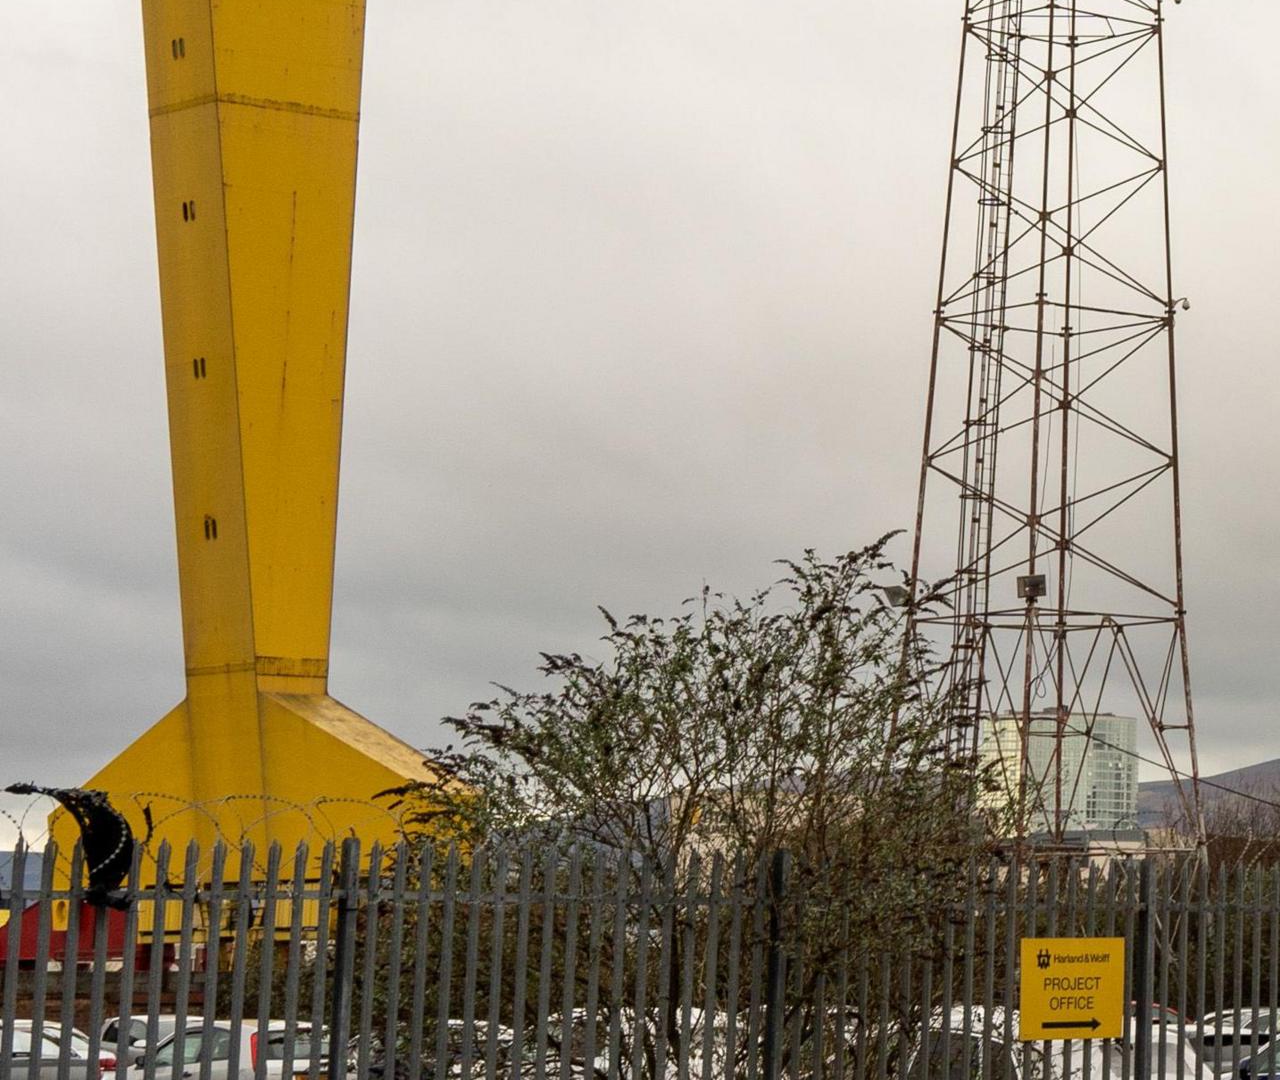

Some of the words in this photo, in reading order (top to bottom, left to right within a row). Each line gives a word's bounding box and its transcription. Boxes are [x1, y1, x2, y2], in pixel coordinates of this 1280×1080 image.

[1053, 952, 1083, 963] Harland
[1043, 976, 1101, 991] PROJECT
[1049, 996, 1094, 1010] OFFICE
